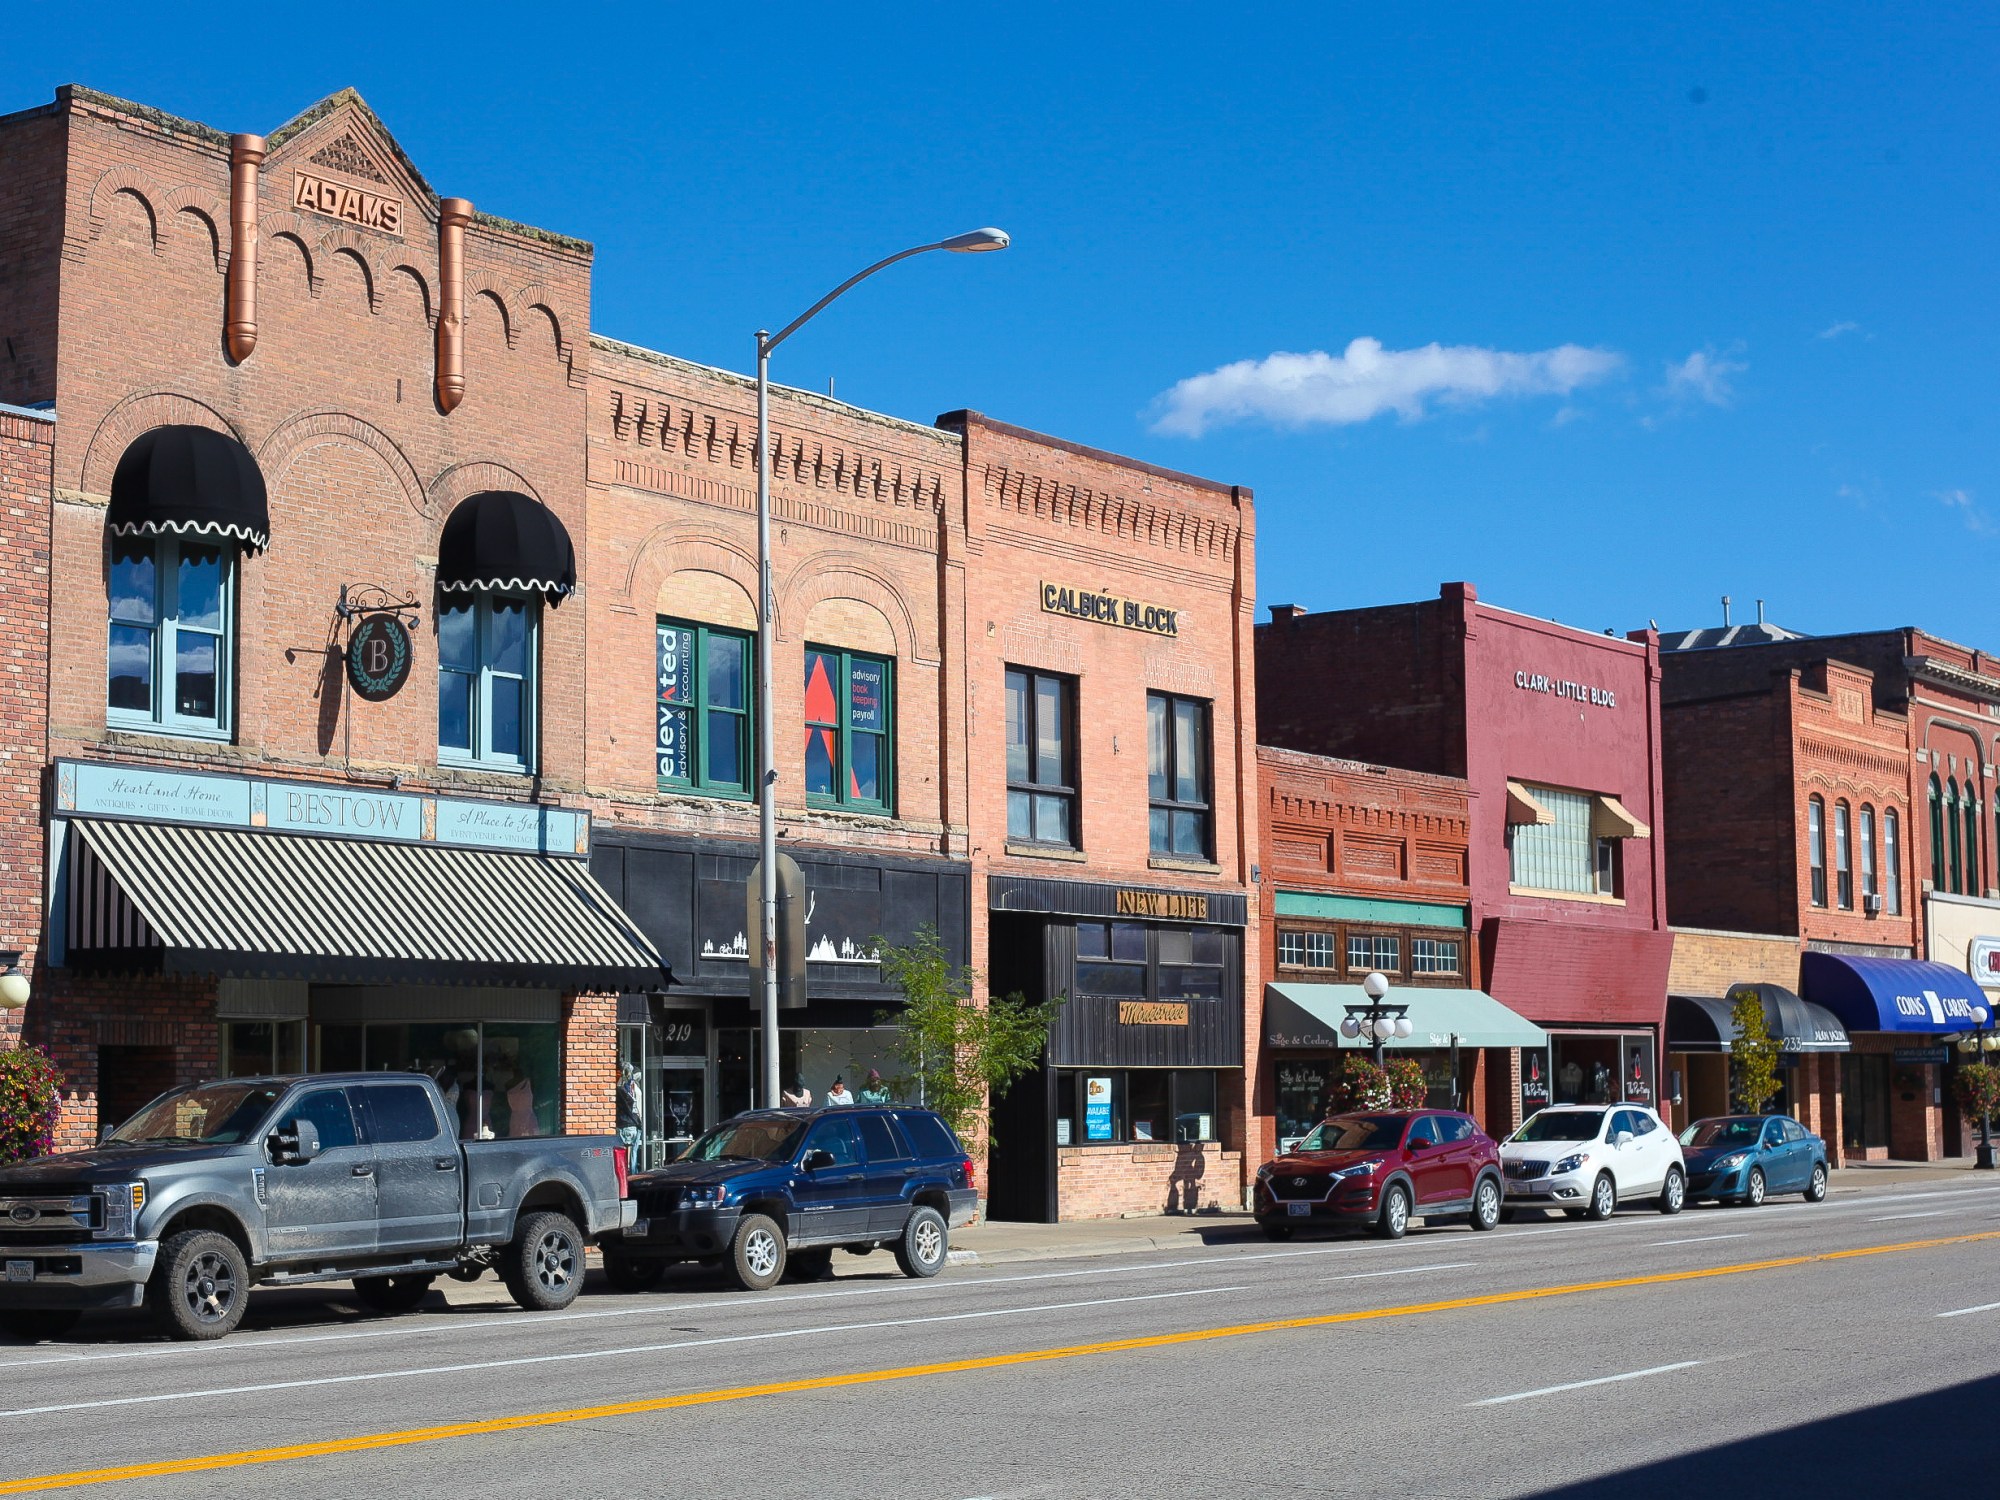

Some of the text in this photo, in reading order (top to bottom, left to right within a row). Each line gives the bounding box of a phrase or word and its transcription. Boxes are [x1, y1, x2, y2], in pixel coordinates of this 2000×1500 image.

[296, 177, 400, 232] ADAMS
[1044, 584, 1178, 634] CALBICK BLOCK
[368, 639, 388, 673] B
[852, 669, 880, 686] advisory
[1515, 670, 1587, 702] CLARK-LITTLE
[852, 682, 868, 694] book
[852, 694, 878, 709] keeping
[678, 711, 686, 720] &
[852, 708, 875, 722] payroll
[107, 778, 221, 802] Heart and Home
[93, 798, 234, 819] ANTIQUES GIFTS HOME DECOR
[285, 792, 404, 831] BESTOW
[456, 808, 473, 824] A
[474, 810, 500, 827] Place
[501, 813, 514, 828] to
[450, 829, 474, 839] EVENT
[474, 832, 497, 841] VENUE
[504, 834, 536, 845] VINTAGE
[1120, 891, 1207, 919] NEW LIFE
[1896, 995, 1973, 1017] COINS CARATS
[665, 1023, 692, 1042] 219
[1269, 1033, 1330, 1047] Sage & Cedar
[1783, 1036, 1802, 1051] 233
